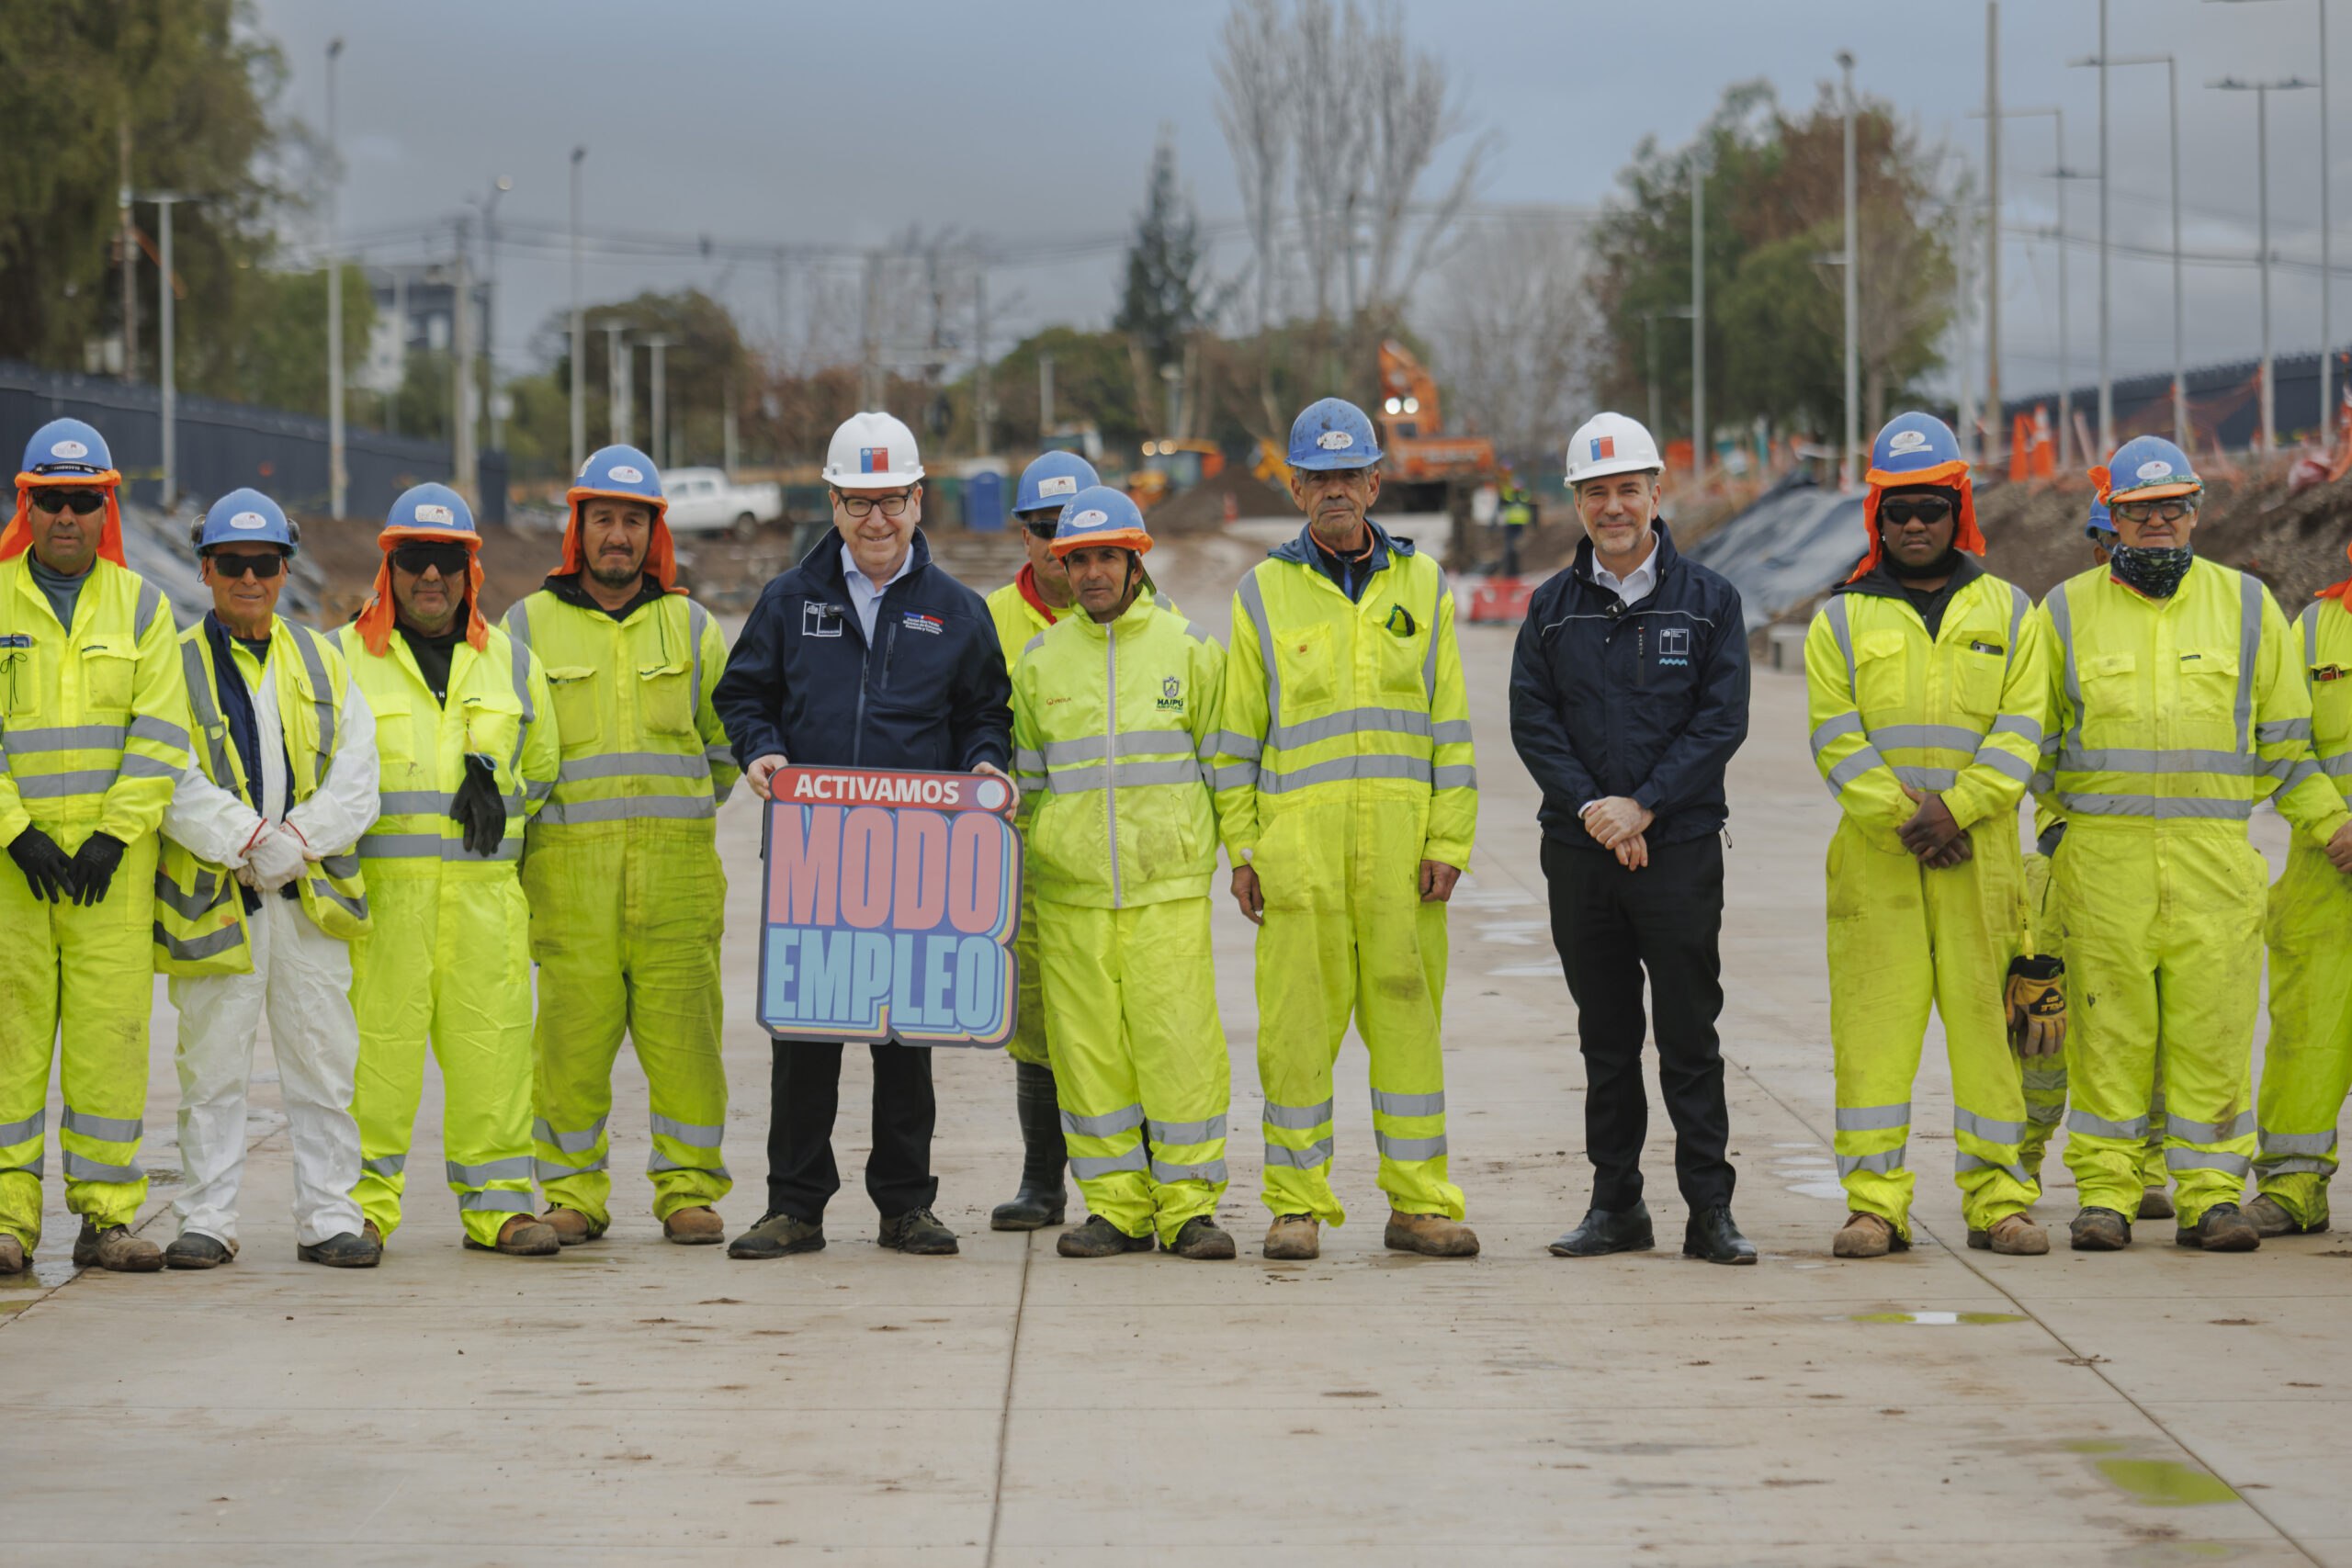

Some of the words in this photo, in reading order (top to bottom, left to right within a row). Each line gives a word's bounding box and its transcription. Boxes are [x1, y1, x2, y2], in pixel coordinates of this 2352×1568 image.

[793, 773, 960, 805] ACTIVAMOS
[767, 805, 1002, 933] MODO
[764, 927, 997, 1029] EMPLEO
